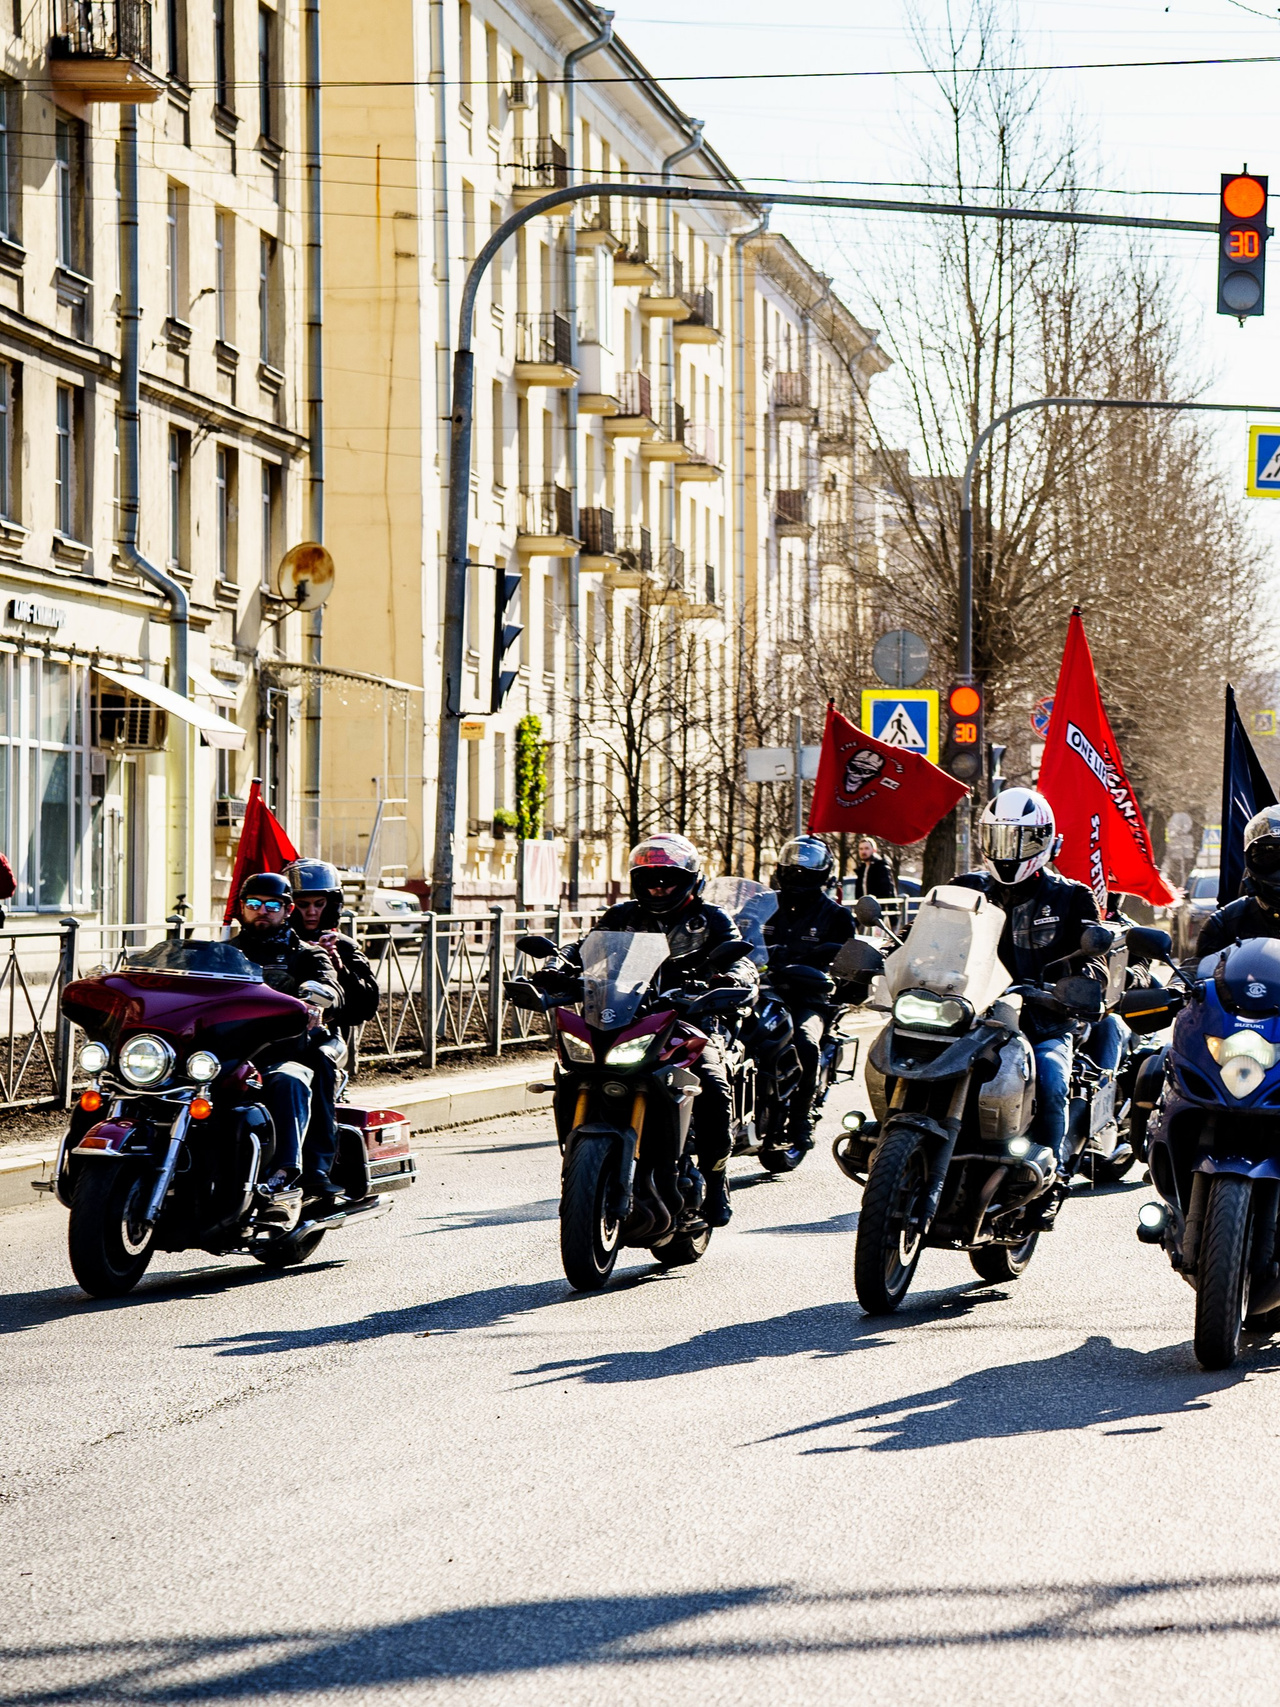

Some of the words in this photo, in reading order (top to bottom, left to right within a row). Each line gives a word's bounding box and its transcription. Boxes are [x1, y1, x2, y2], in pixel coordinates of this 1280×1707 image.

[1229, 230, 1259, 257] 30
[955, 722, 977, 743] 30
[1071, 731, 1093, 765] ONE
[1234, 1022, 1264, 1030] SUZUKI
